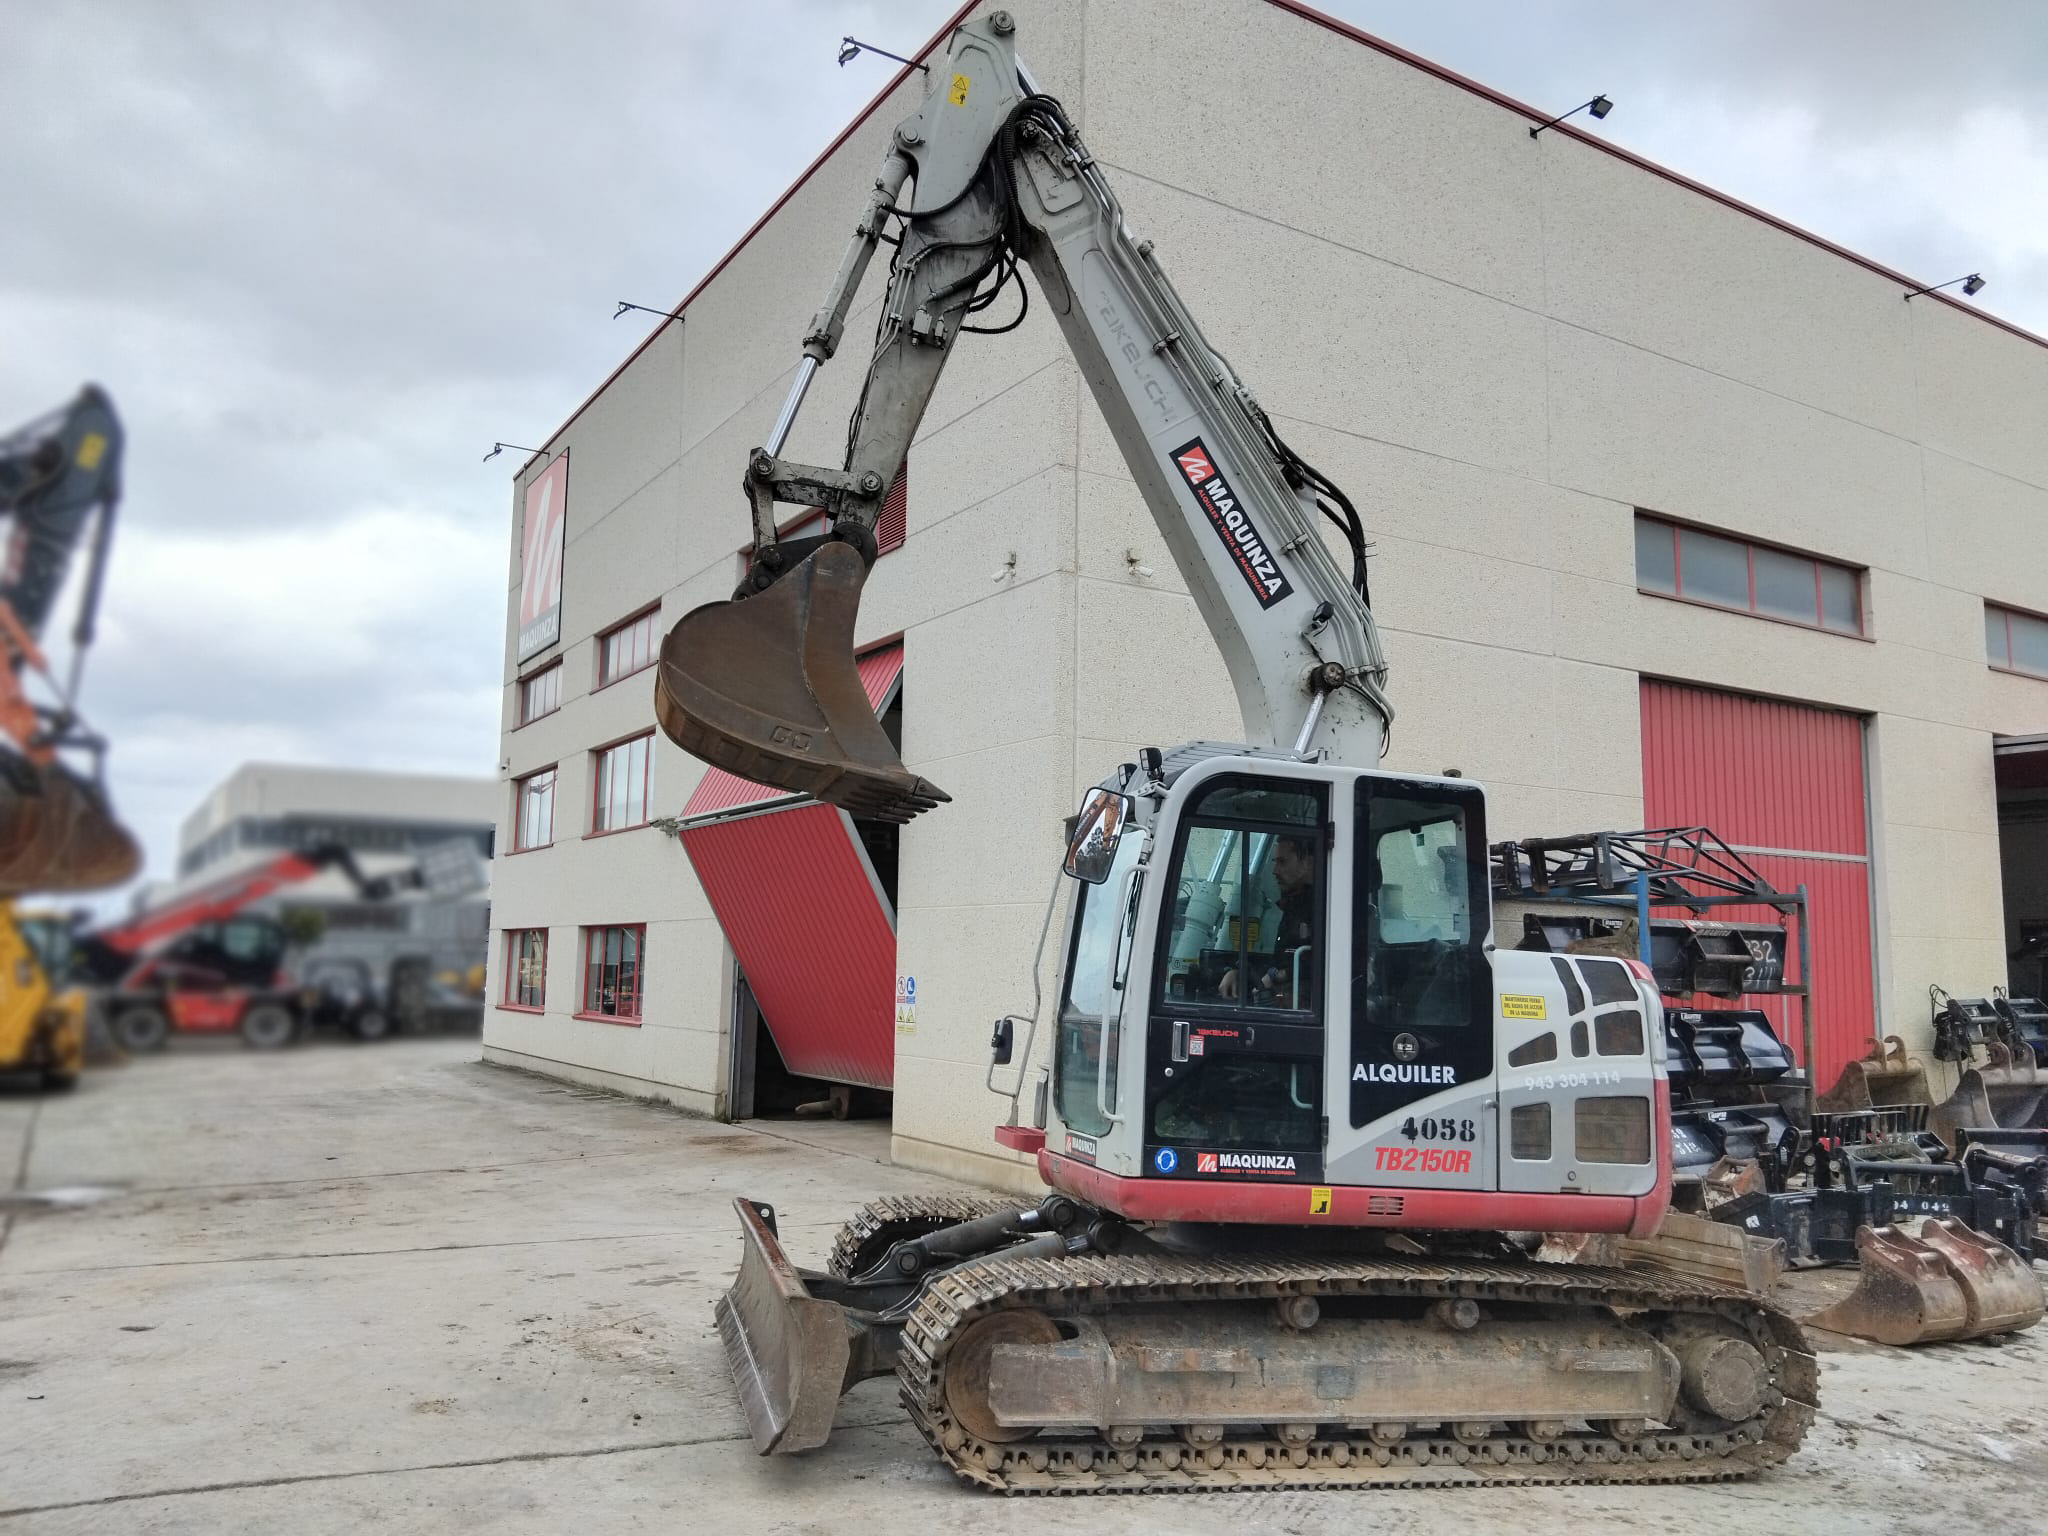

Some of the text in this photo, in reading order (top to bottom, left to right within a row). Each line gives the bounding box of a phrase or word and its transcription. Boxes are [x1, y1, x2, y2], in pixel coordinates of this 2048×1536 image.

[1197, 488, 1219, 520] ALQUILER
[1220, 525, 1235, 548] VENTA
[1233, 547, 1241, 556] DE
[1239, 557, 1268, 600] MAQUINARIA
[1205, 478, 1282, 596] MAQUINZA
[1352, 1063, 1456, 1083] ALQUILER
[1525, 1070, 1621, 1090] 943 304 114
[1400, 1117, 1476, 1142] 4058
[1219, 1154, 1296, 1169] MAQUINZA
[1375, 1147, 1472, 1173] TB2150R
